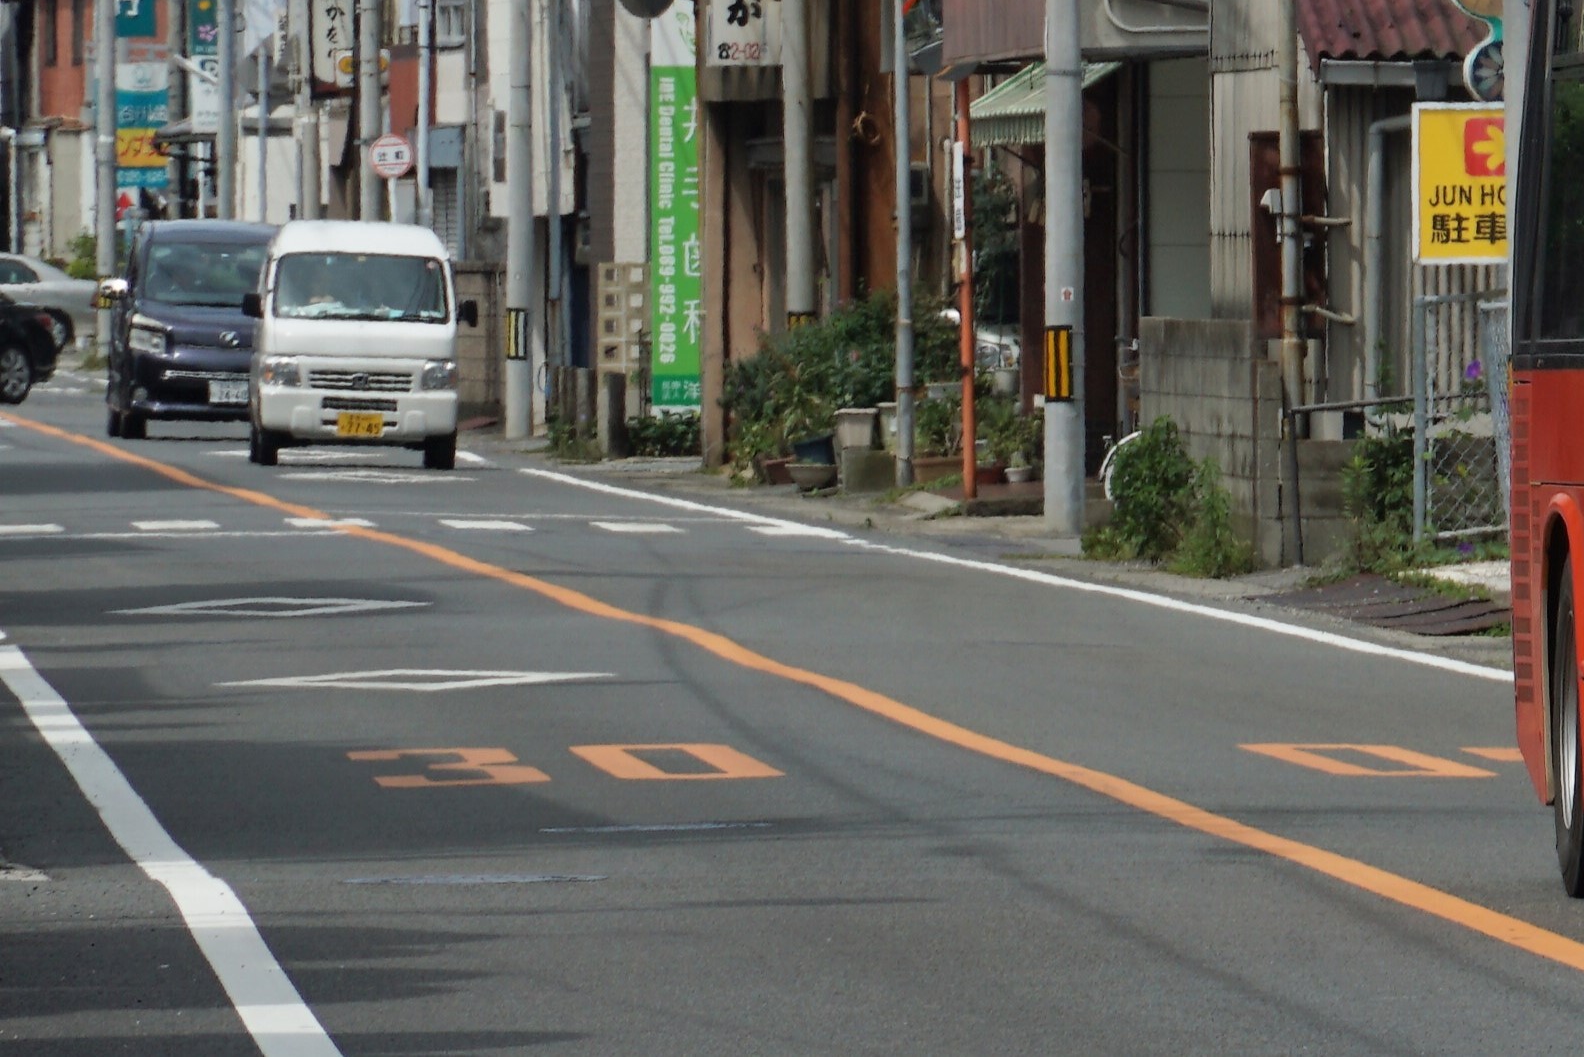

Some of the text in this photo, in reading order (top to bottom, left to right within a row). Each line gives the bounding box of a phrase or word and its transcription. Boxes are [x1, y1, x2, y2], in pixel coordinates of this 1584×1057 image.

[659, 105, 676, 158] Dental
[659, 161, 676, 210] Clinic
[1429, 185, 1472, 207] JUN
